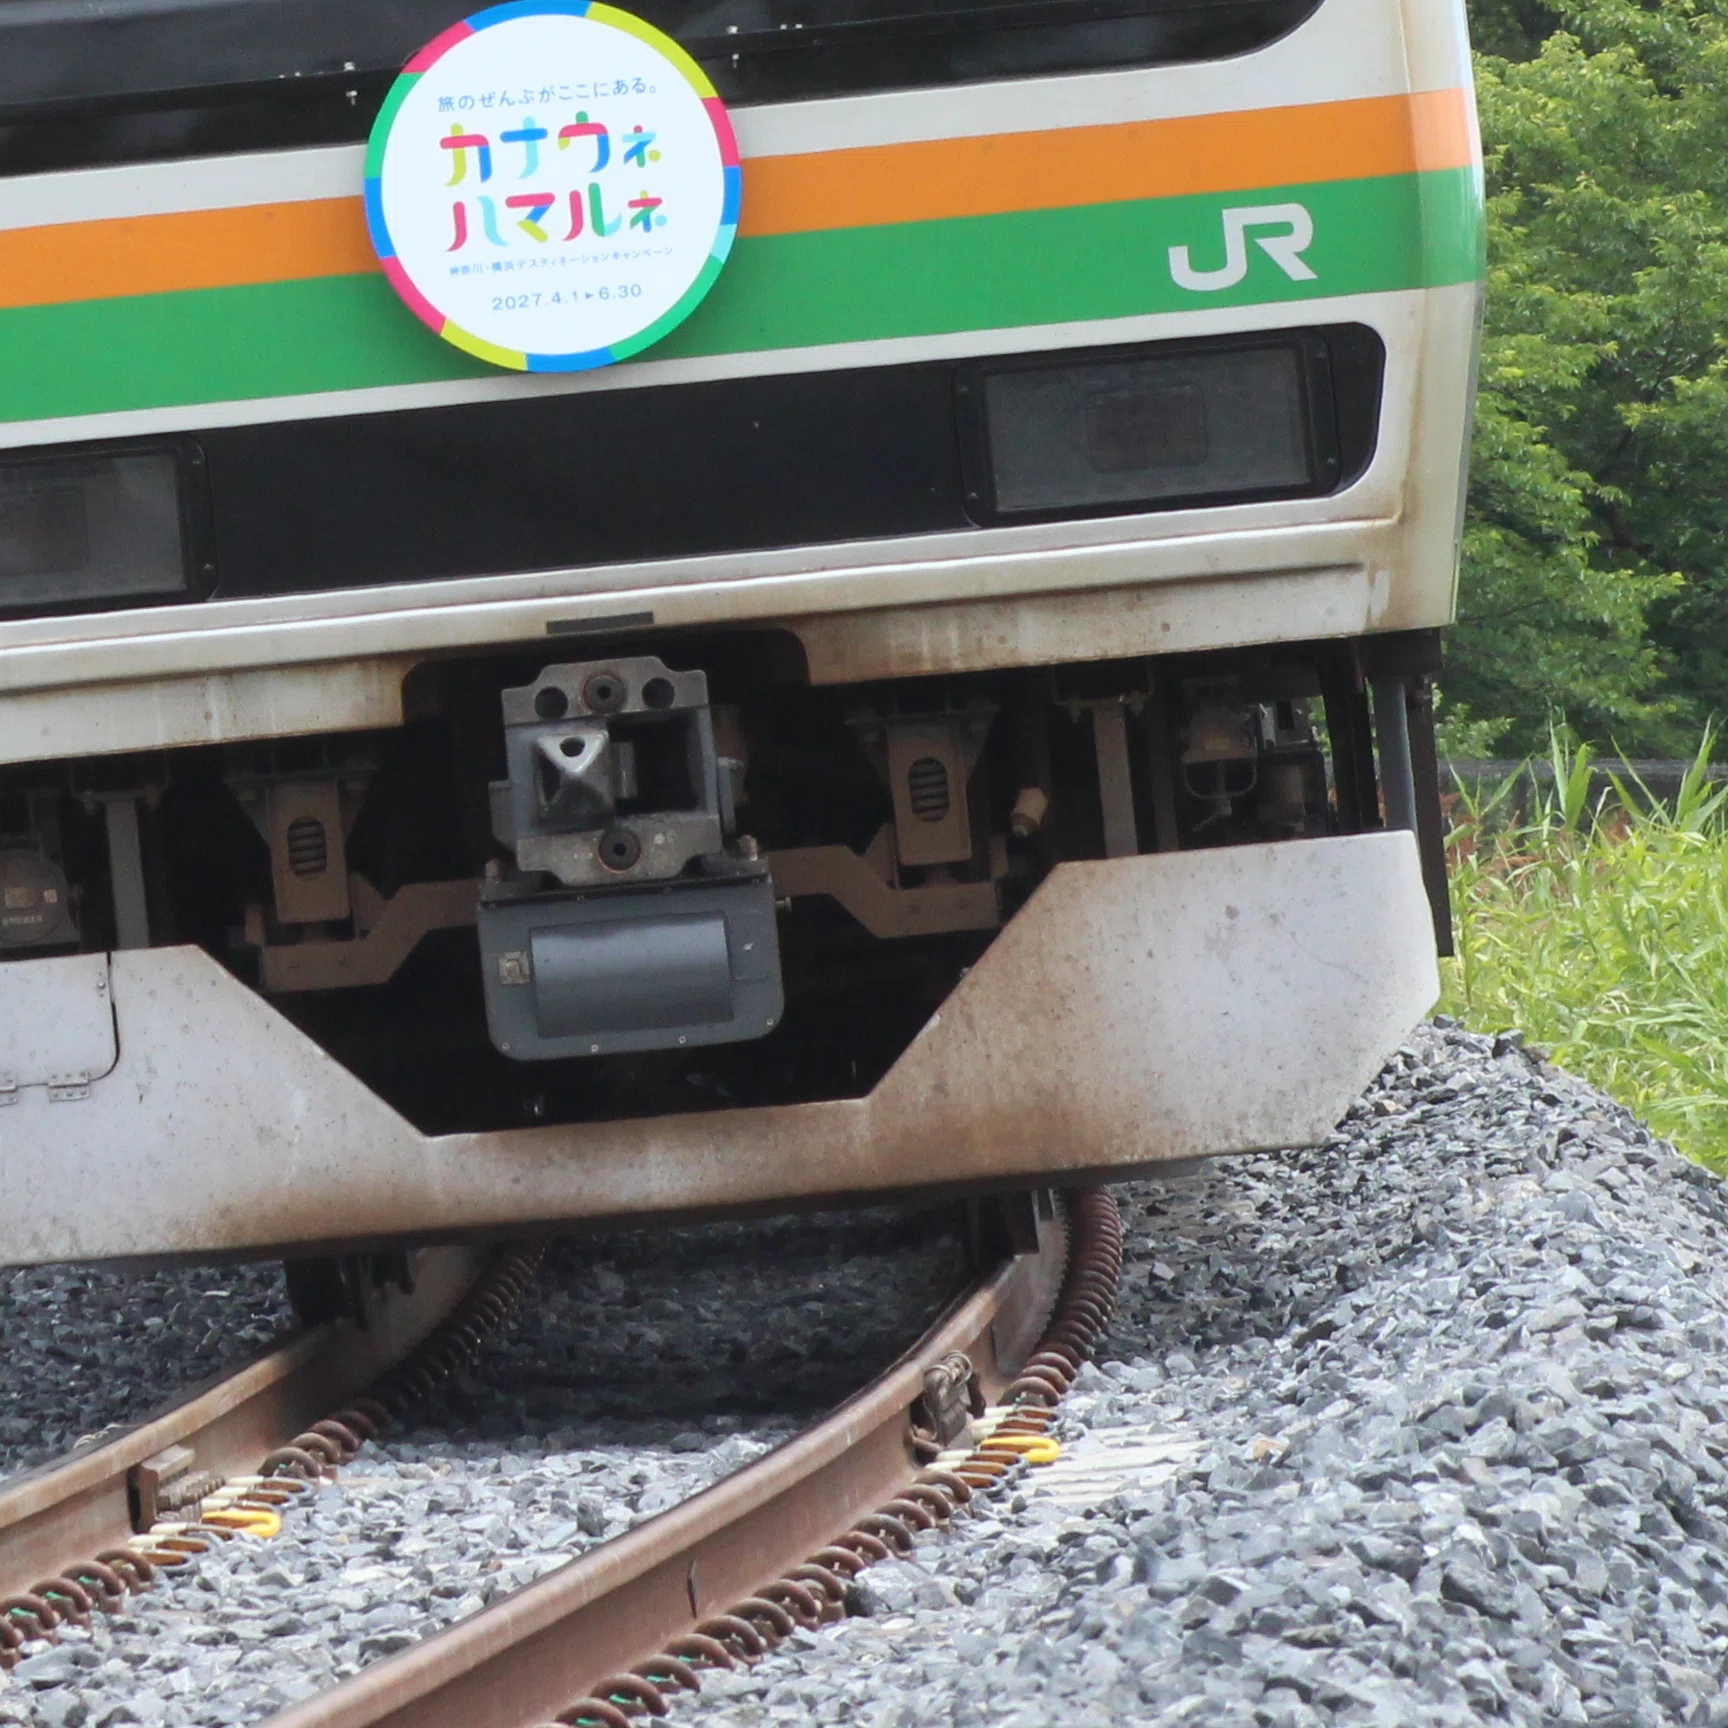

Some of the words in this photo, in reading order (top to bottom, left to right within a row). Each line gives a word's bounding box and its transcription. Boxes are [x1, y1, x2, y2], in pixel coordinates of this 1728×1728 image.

[438, 76, 658, 112] 旅のぜんぶがここにある。
[1167, 202, 1319, 292] JR
